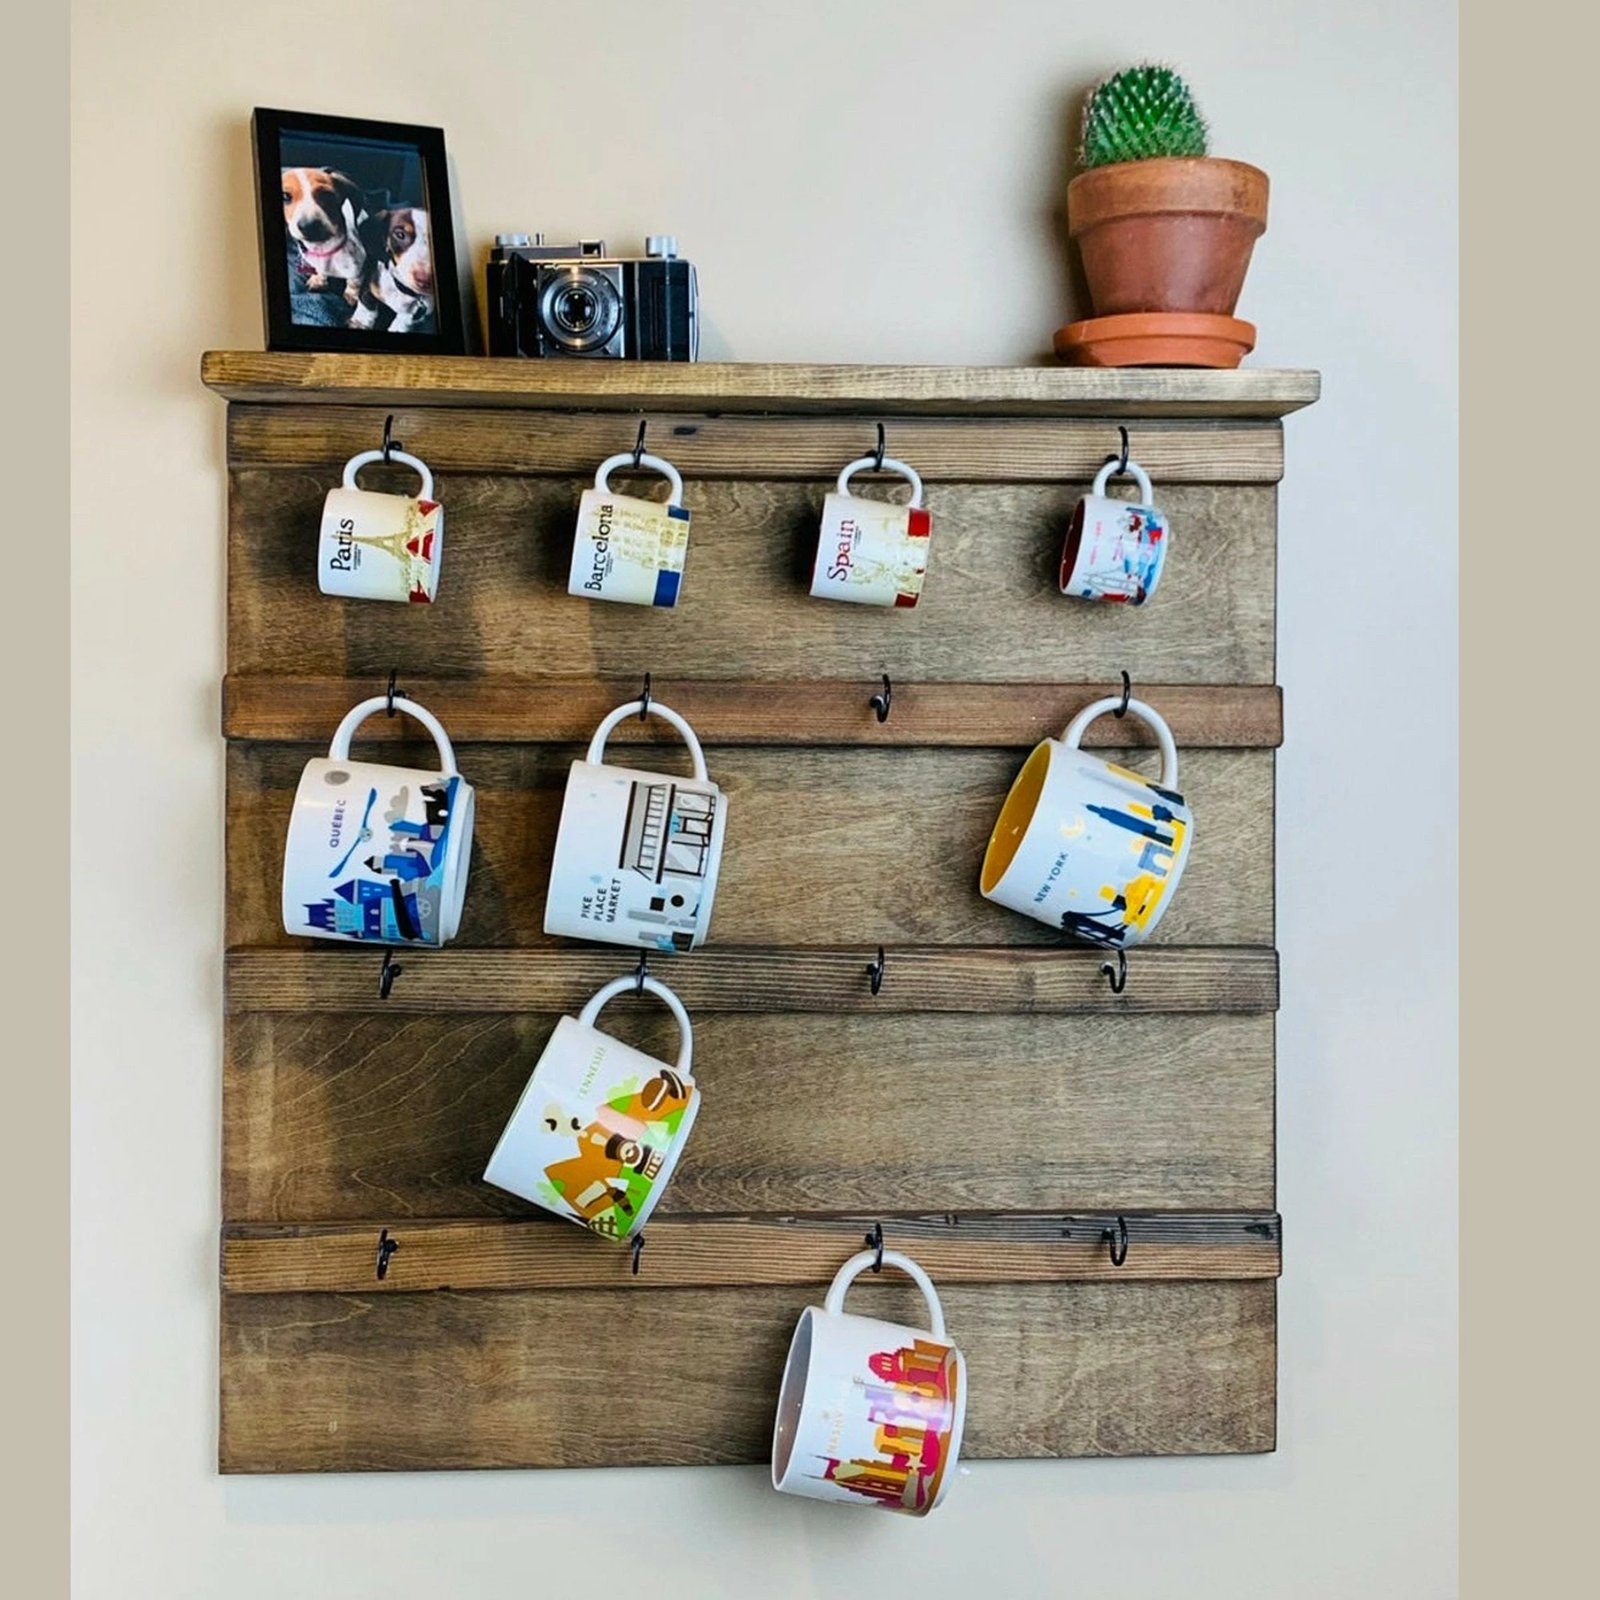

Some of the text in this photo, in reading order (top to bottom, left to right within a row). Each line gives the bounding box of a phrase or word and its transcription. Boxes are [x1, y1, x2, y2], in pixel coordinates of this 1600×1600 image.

[330, 518, 354, 571] Paris
[584, 504, 613, 591] Barcelona
[827, 519, 854, 582] Spain
[606, 878, 621, 922] MARKET
[1034, 852, 1069, 903] NEW YORK
[581, 896, 593, 919] PIKE
[594, 888, 607, 921] PLACE
